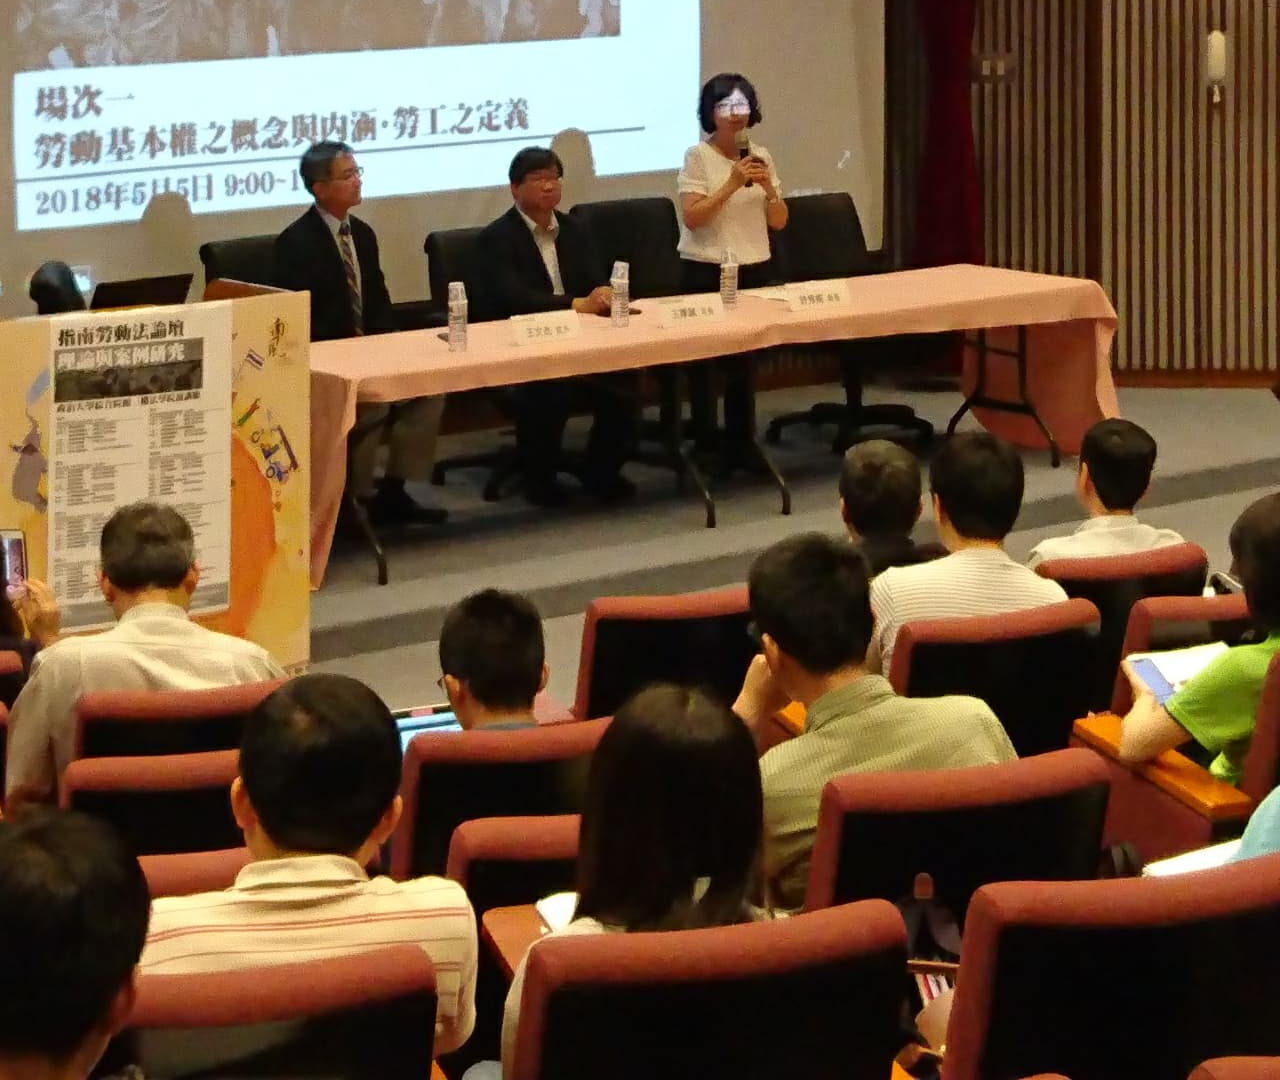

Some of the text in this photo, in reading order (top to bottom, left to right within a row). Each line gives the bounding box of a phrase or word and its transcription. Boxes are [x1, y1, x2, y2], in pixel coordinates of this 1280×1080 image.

[35, 83, 136, 121] 場次一
[224, 170, 301, 197] 9:00~1
[58, 320, 184, 346] 指南勞動法論壇
[57, 342, 185, 370] 理論與案例研究
